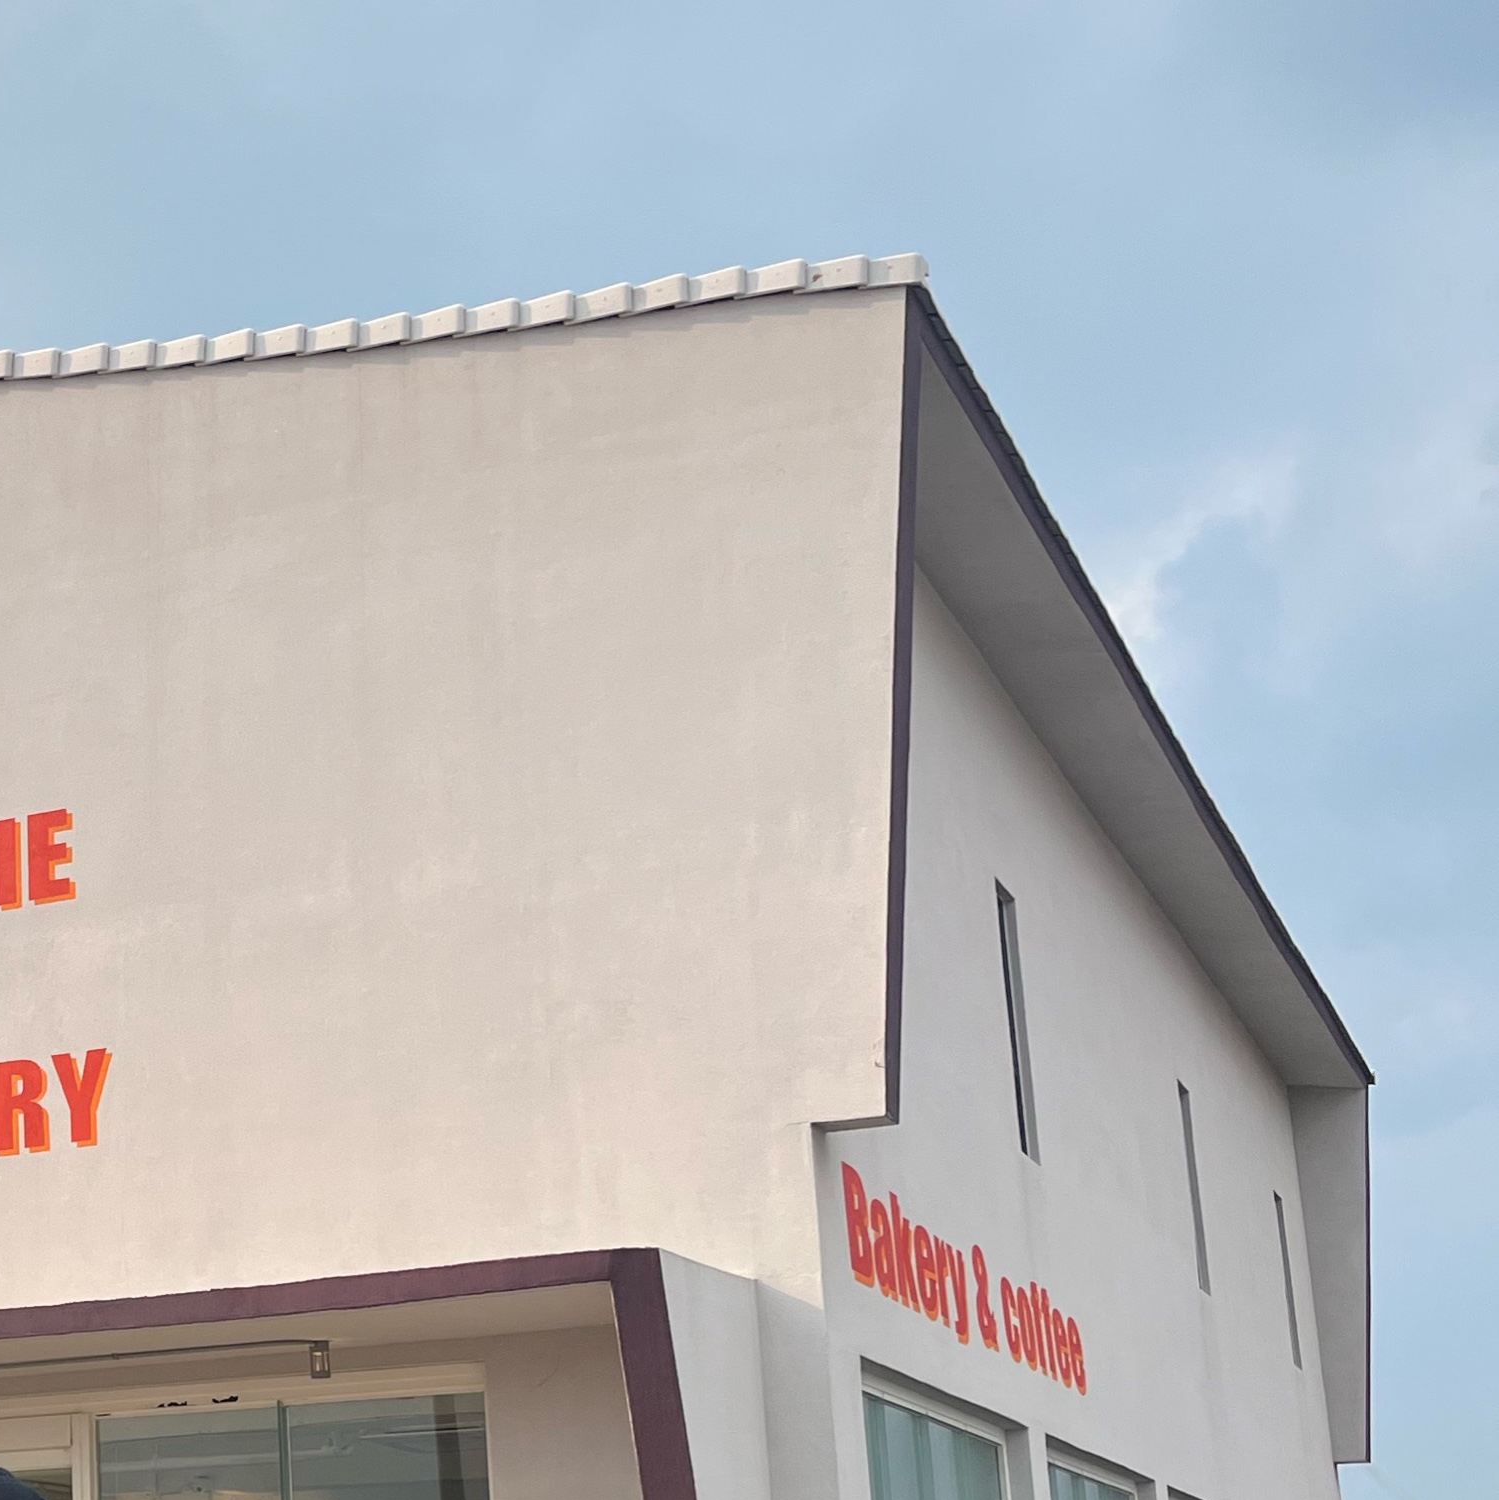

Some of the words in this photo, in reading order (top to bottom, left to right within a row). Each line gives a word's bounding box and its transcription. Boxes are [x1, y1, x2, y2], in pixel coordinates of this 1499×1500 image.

[841, 1161, 970, 1346] Bakery
[971, 1244, 1000, 1353] &
[1001, 1276, 1087, 1396] coffee
